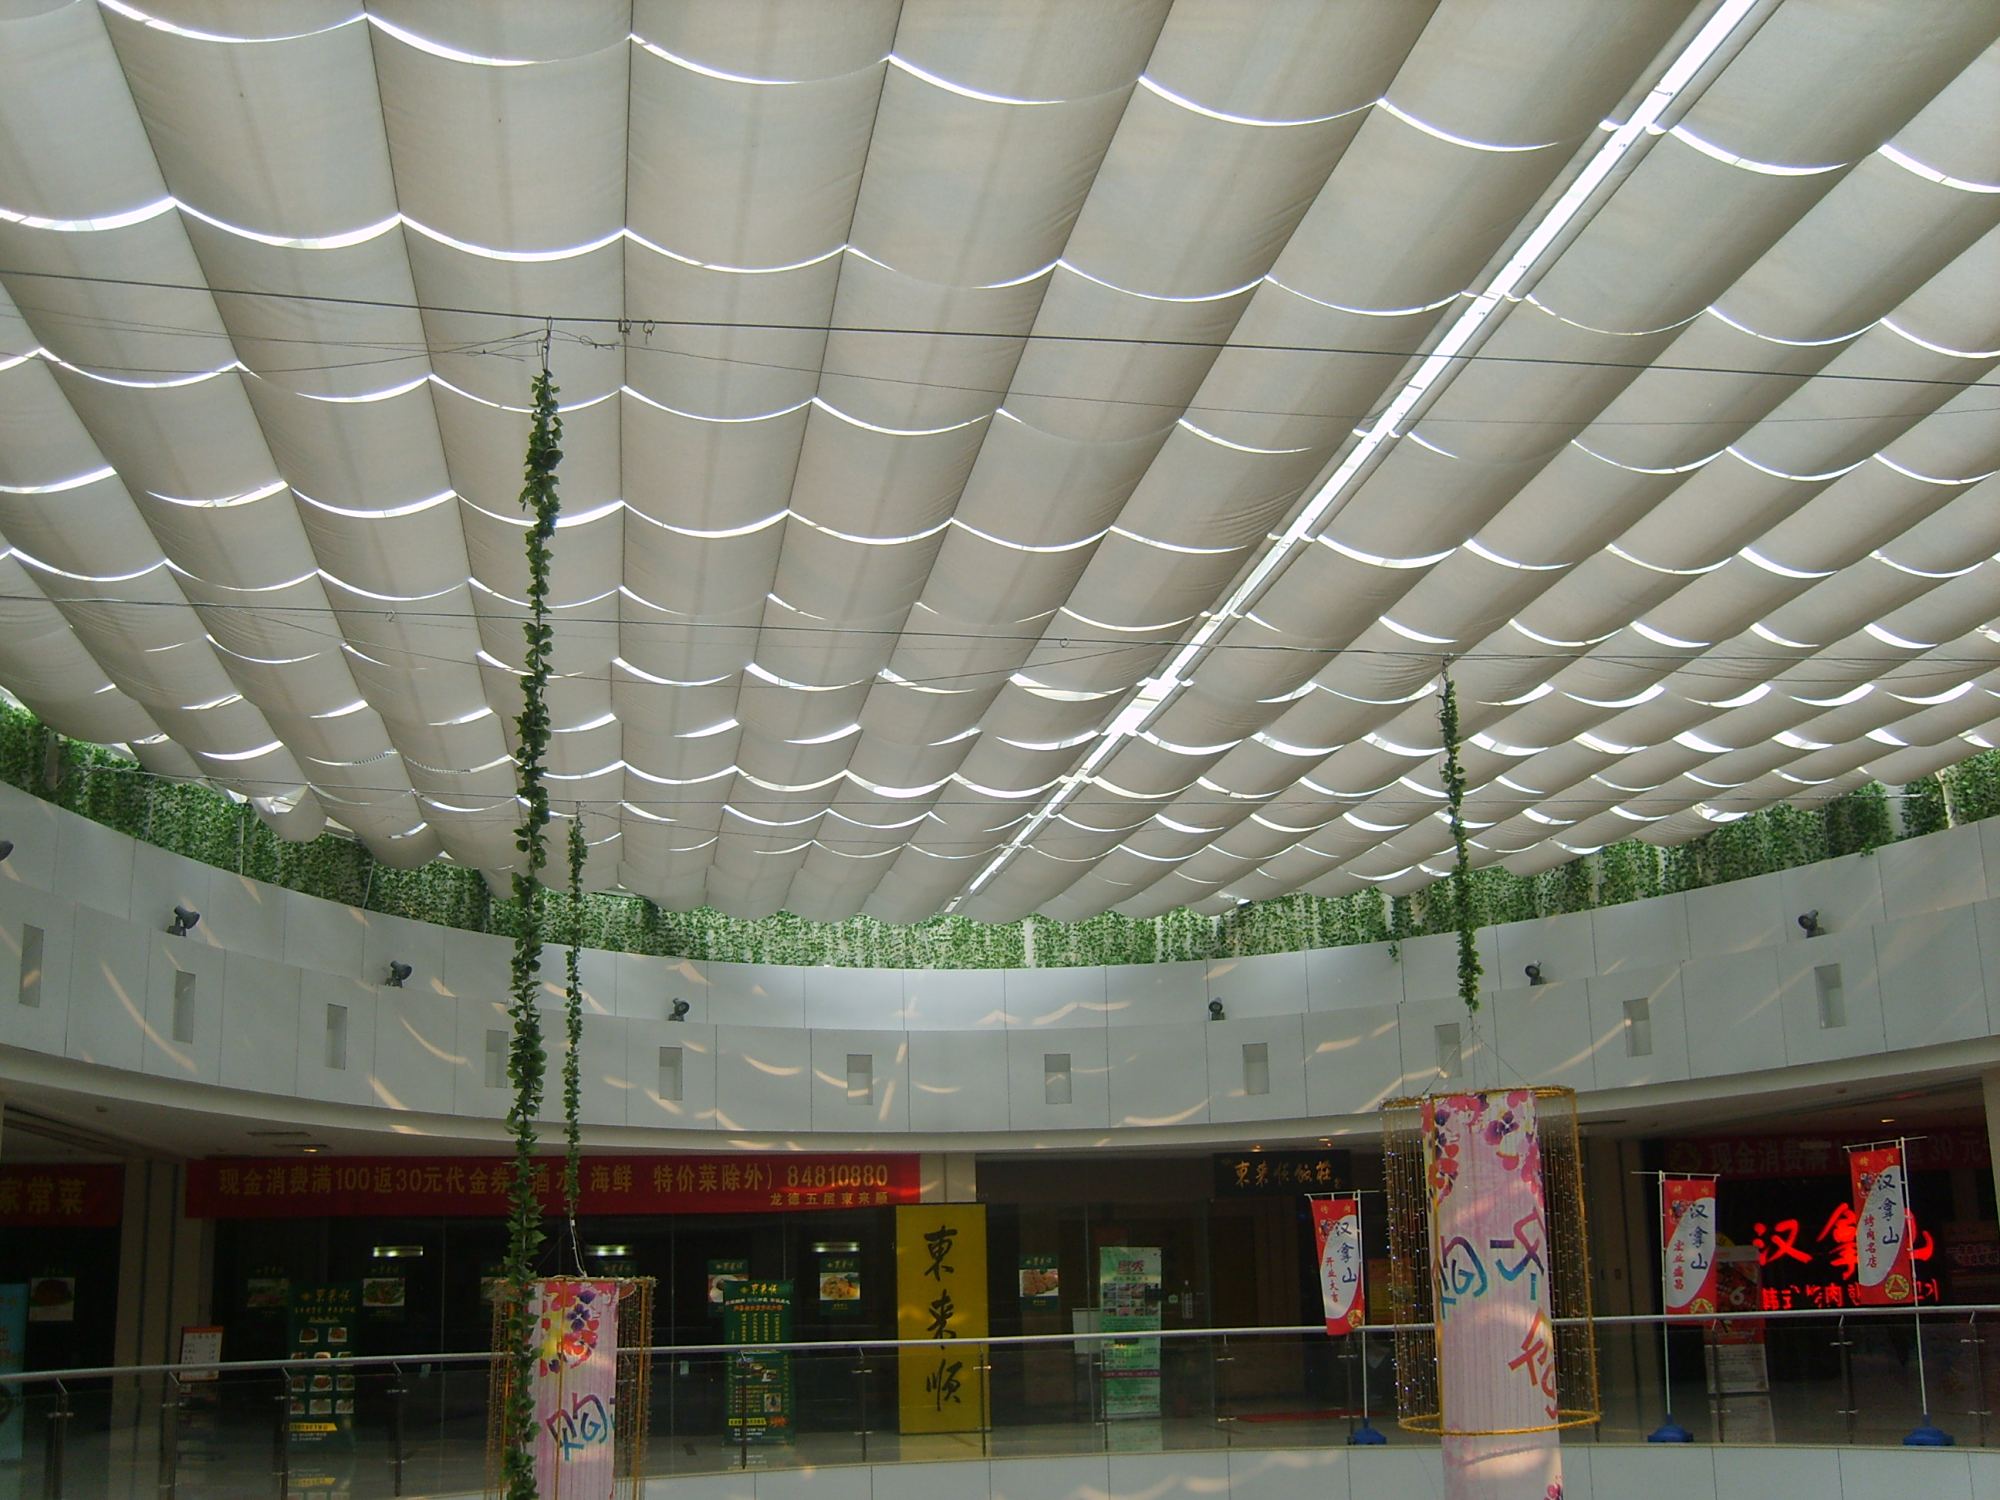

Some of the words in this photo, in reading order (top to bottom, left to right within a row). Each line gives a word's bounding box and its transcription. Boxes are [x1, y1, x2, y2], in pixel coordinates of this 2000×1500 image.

[590, 1164, 633, 1193] 海鲜
[785, 1163, 889, 1189] 84810880
[1877, 1173, 1901, 1246] 汉拿山
[1334, 1221, 1358, 1284] 汉拿山
[1688, 1203, 1709, 1270] 汉拿山
